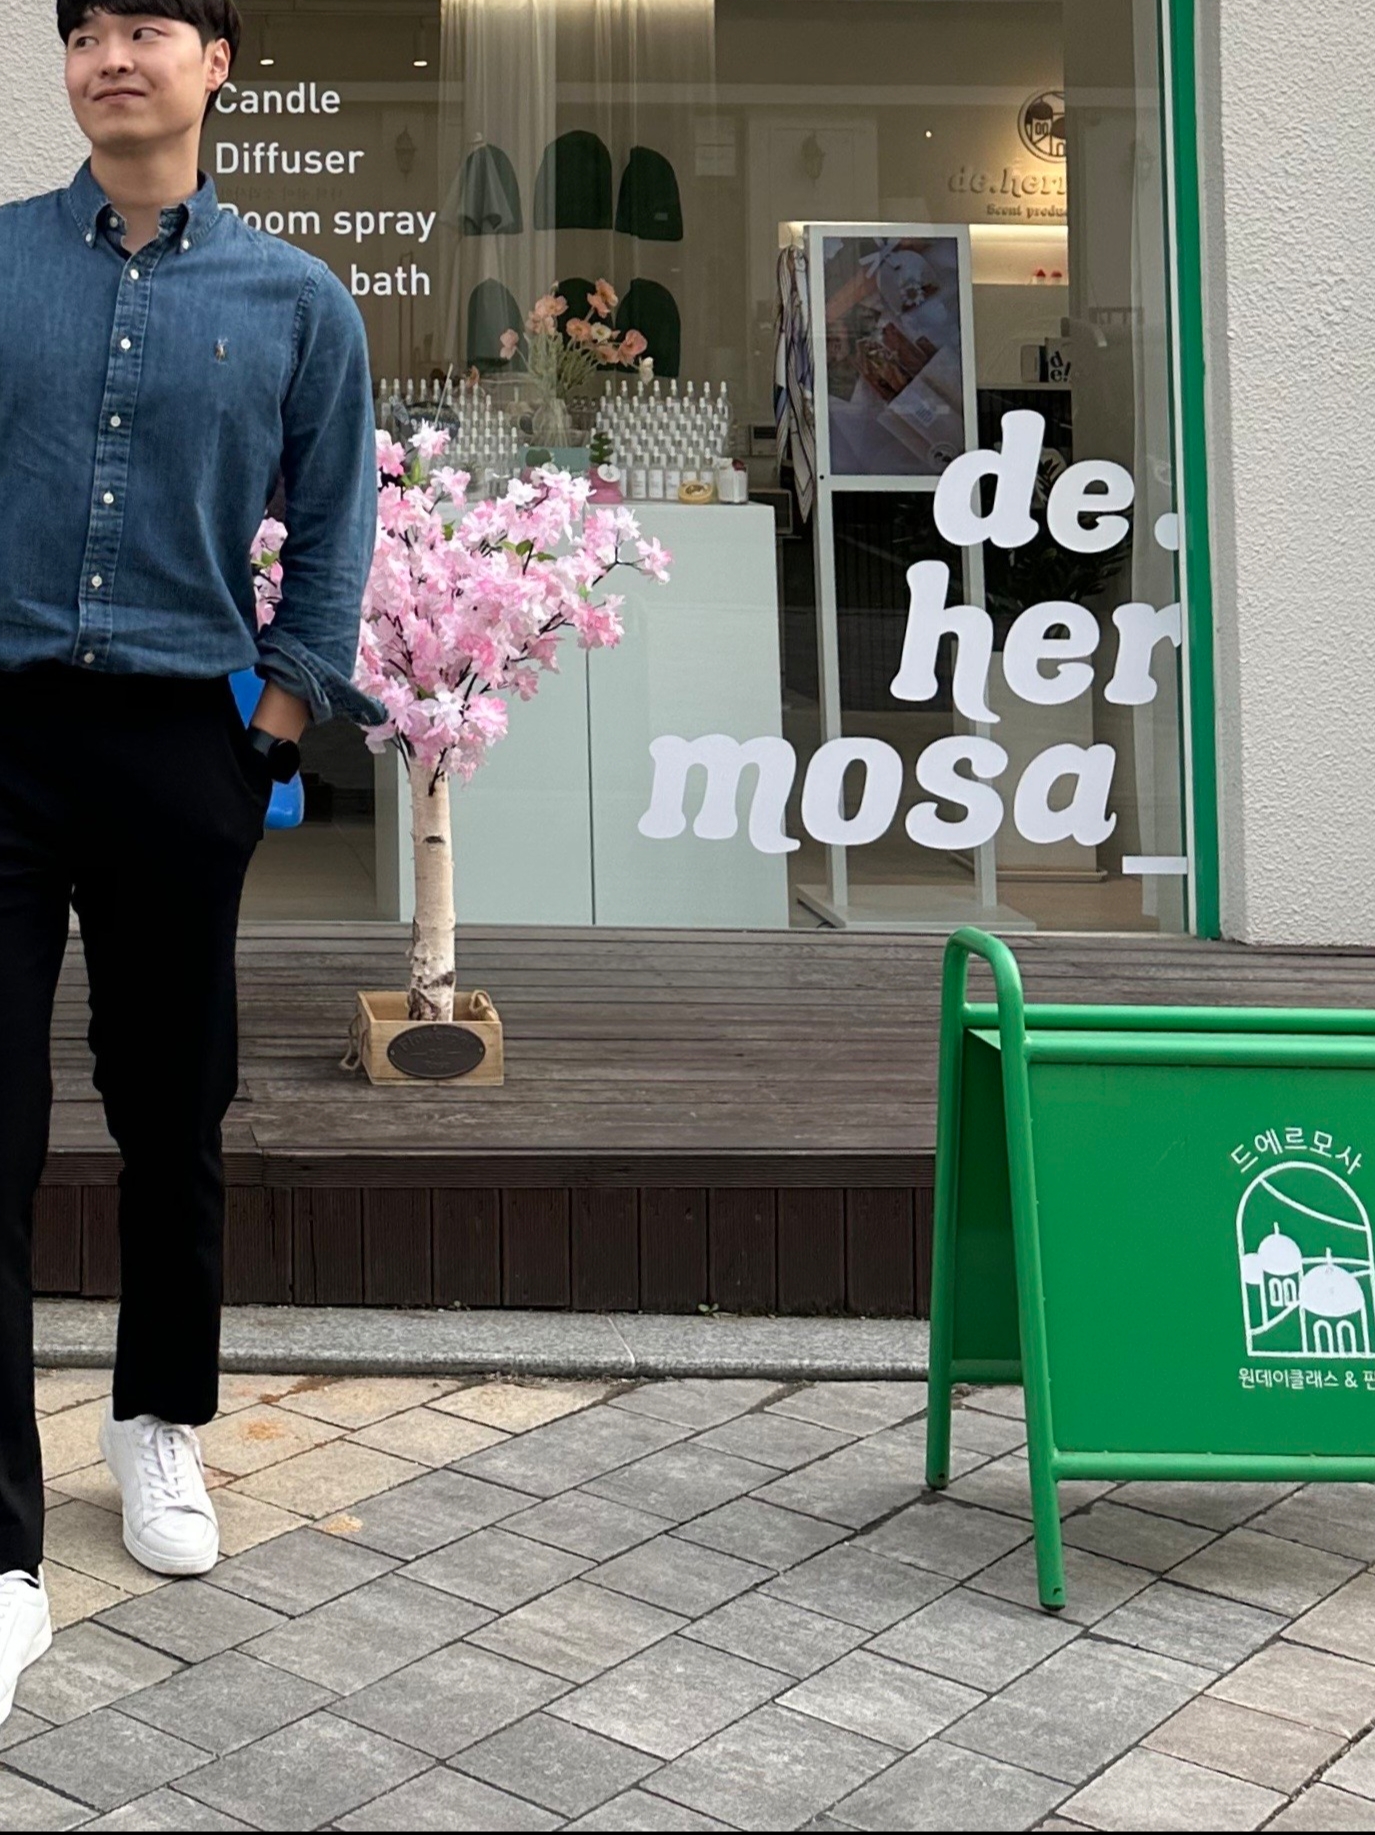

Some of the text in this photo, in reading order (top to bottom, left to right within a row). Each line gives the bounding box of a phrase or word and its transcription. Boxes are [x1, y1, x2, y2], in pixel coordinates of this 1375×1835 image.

[214, 82, 341, 114] Candle
[215, 142, 365, 175] Diffuser
[333, 210, 437, 243] spray
[350, 264, 431, 296] bath
[933, 409, 1180, 554] de.
[890, 560, 1182, 723] her
[1230, 1127, 1362, 1175] 드에르모사
[1238, 1367, 1340, 1390] 원데이클래스
[1344, 1370, 1359, 1388] &
